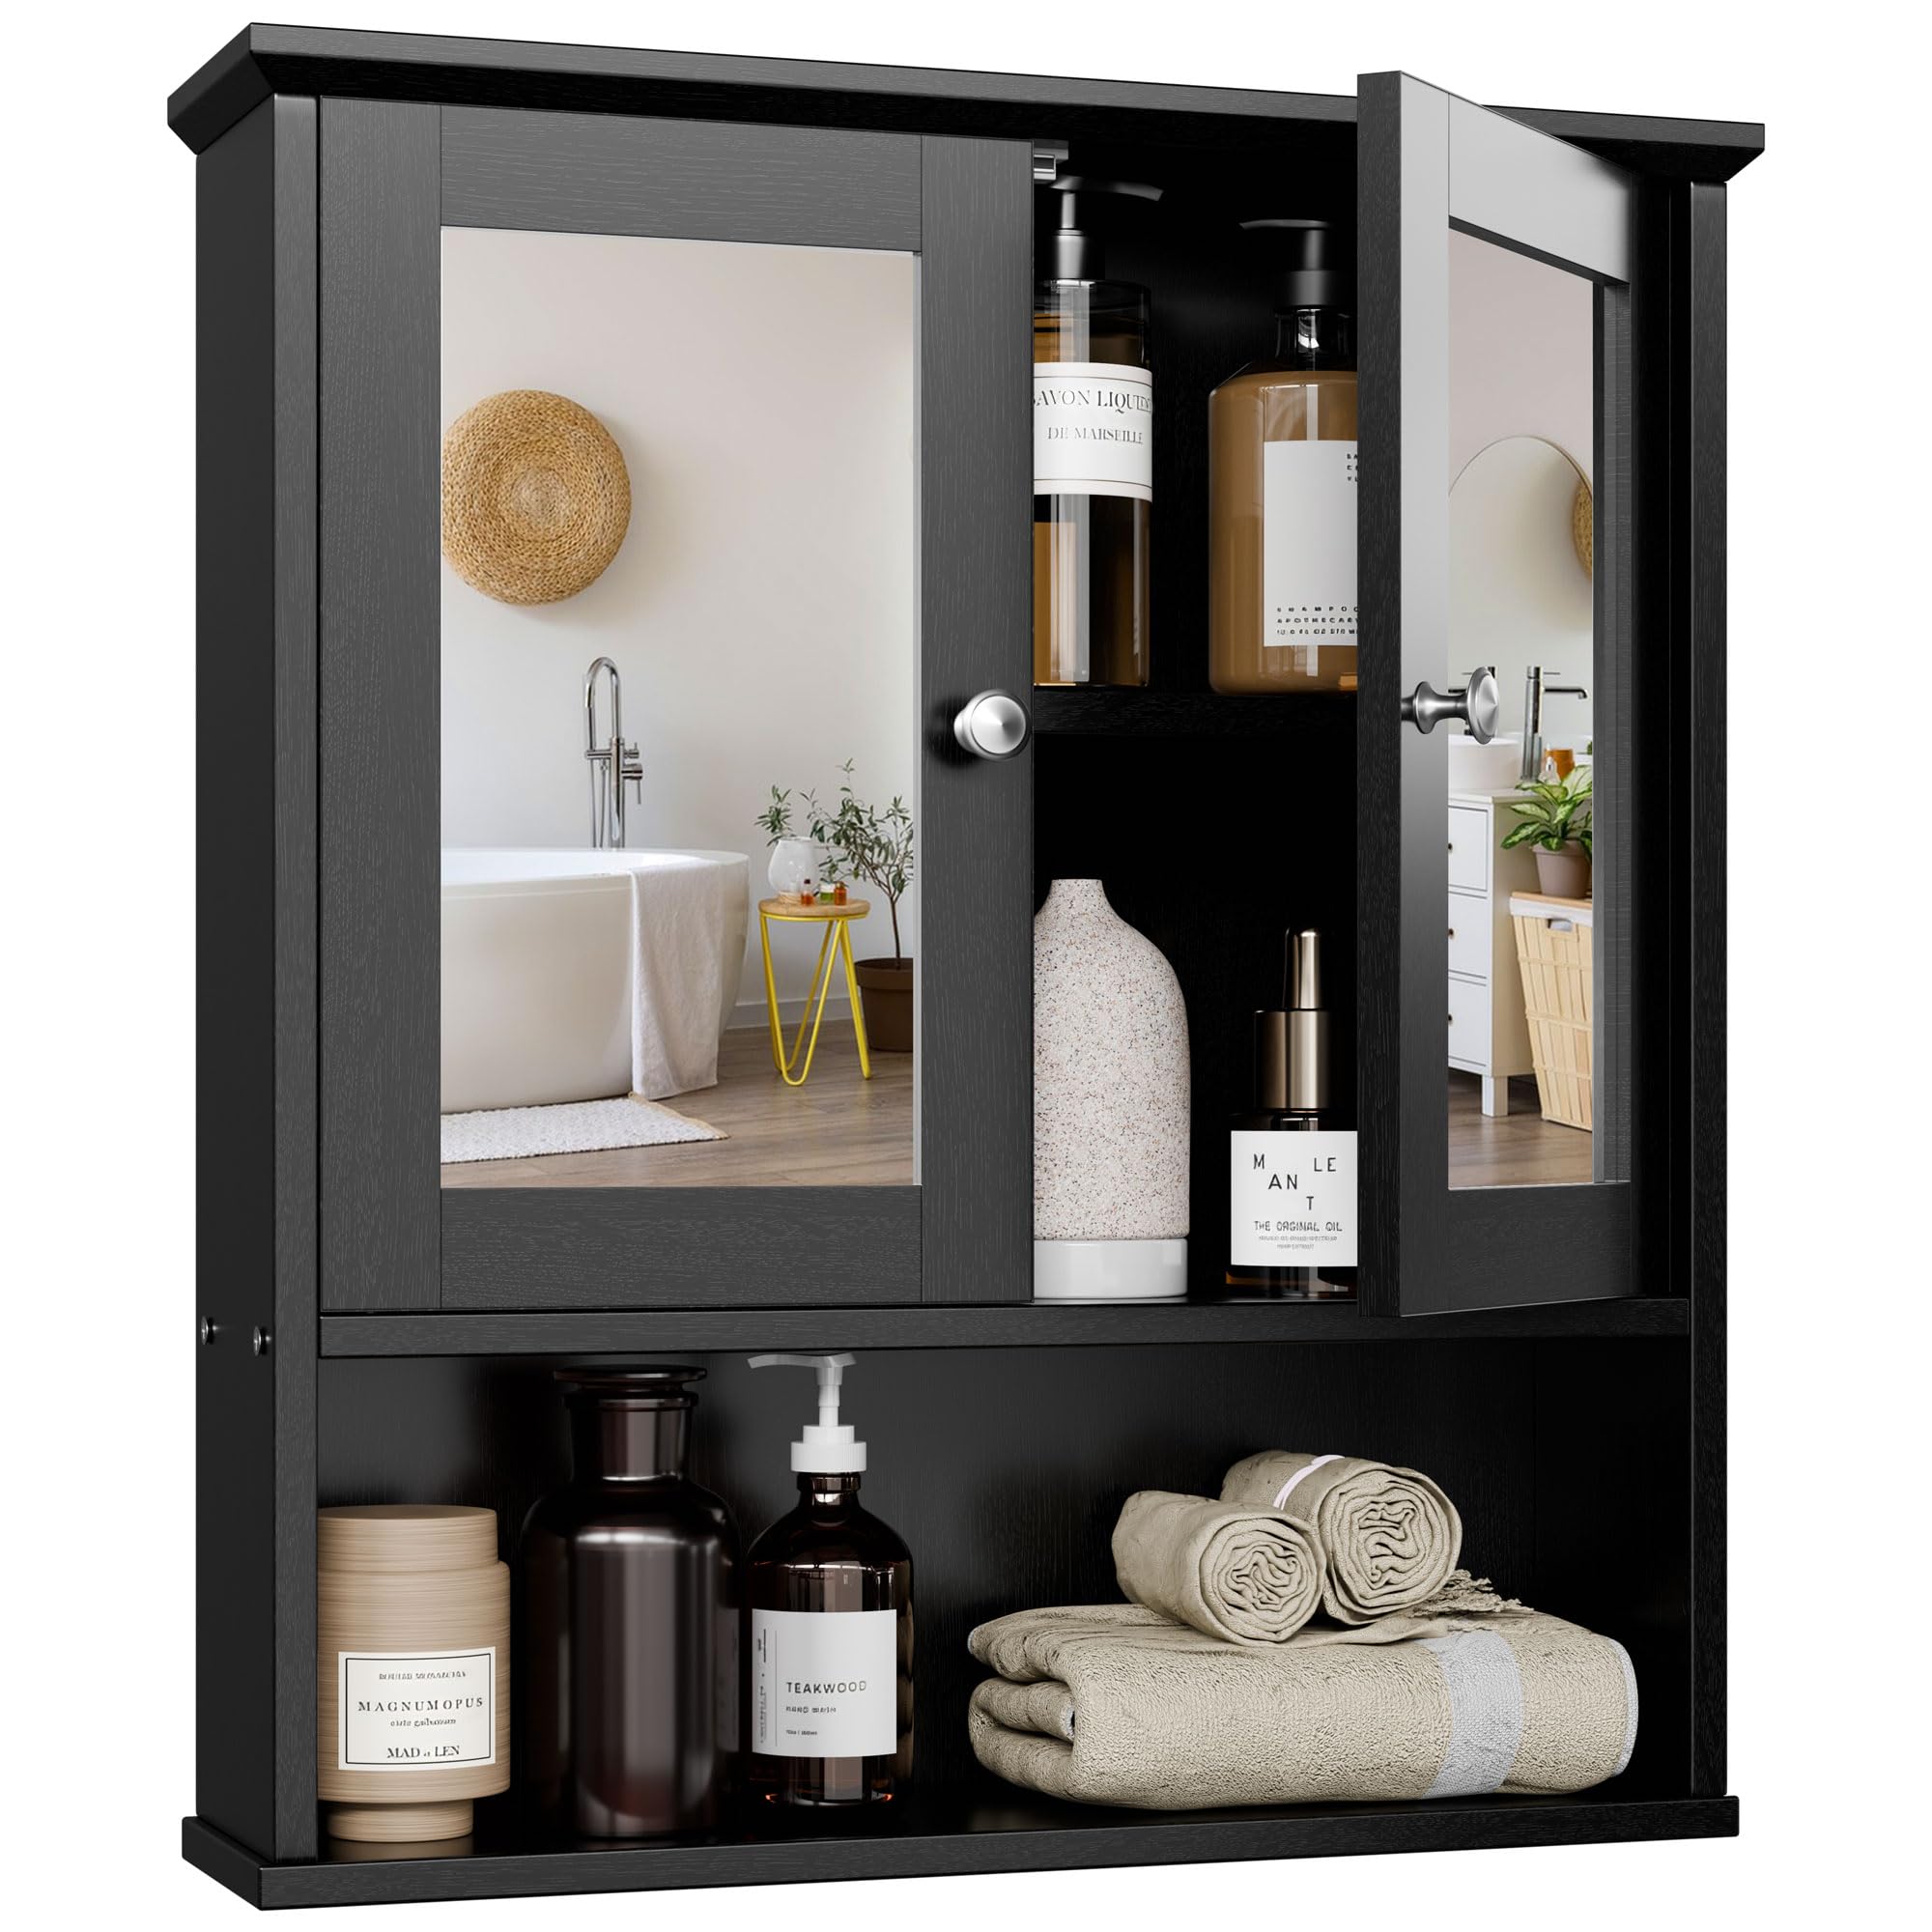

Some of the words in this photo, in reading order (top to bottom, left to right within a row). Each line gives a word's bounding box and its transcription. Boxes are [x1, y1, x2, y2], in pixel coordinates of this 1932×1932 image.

[1034, 389, 1090, 406] AVON
[1074, 427, 1143, 444] MARSEILLE
[1255, 1220, 1270, 1232] THE
[786, 1680, 867, 1693] TEAKWOOD
[386, 1747, 420, 1758] MAD
[435, 1746, 460, 1756] LEN
